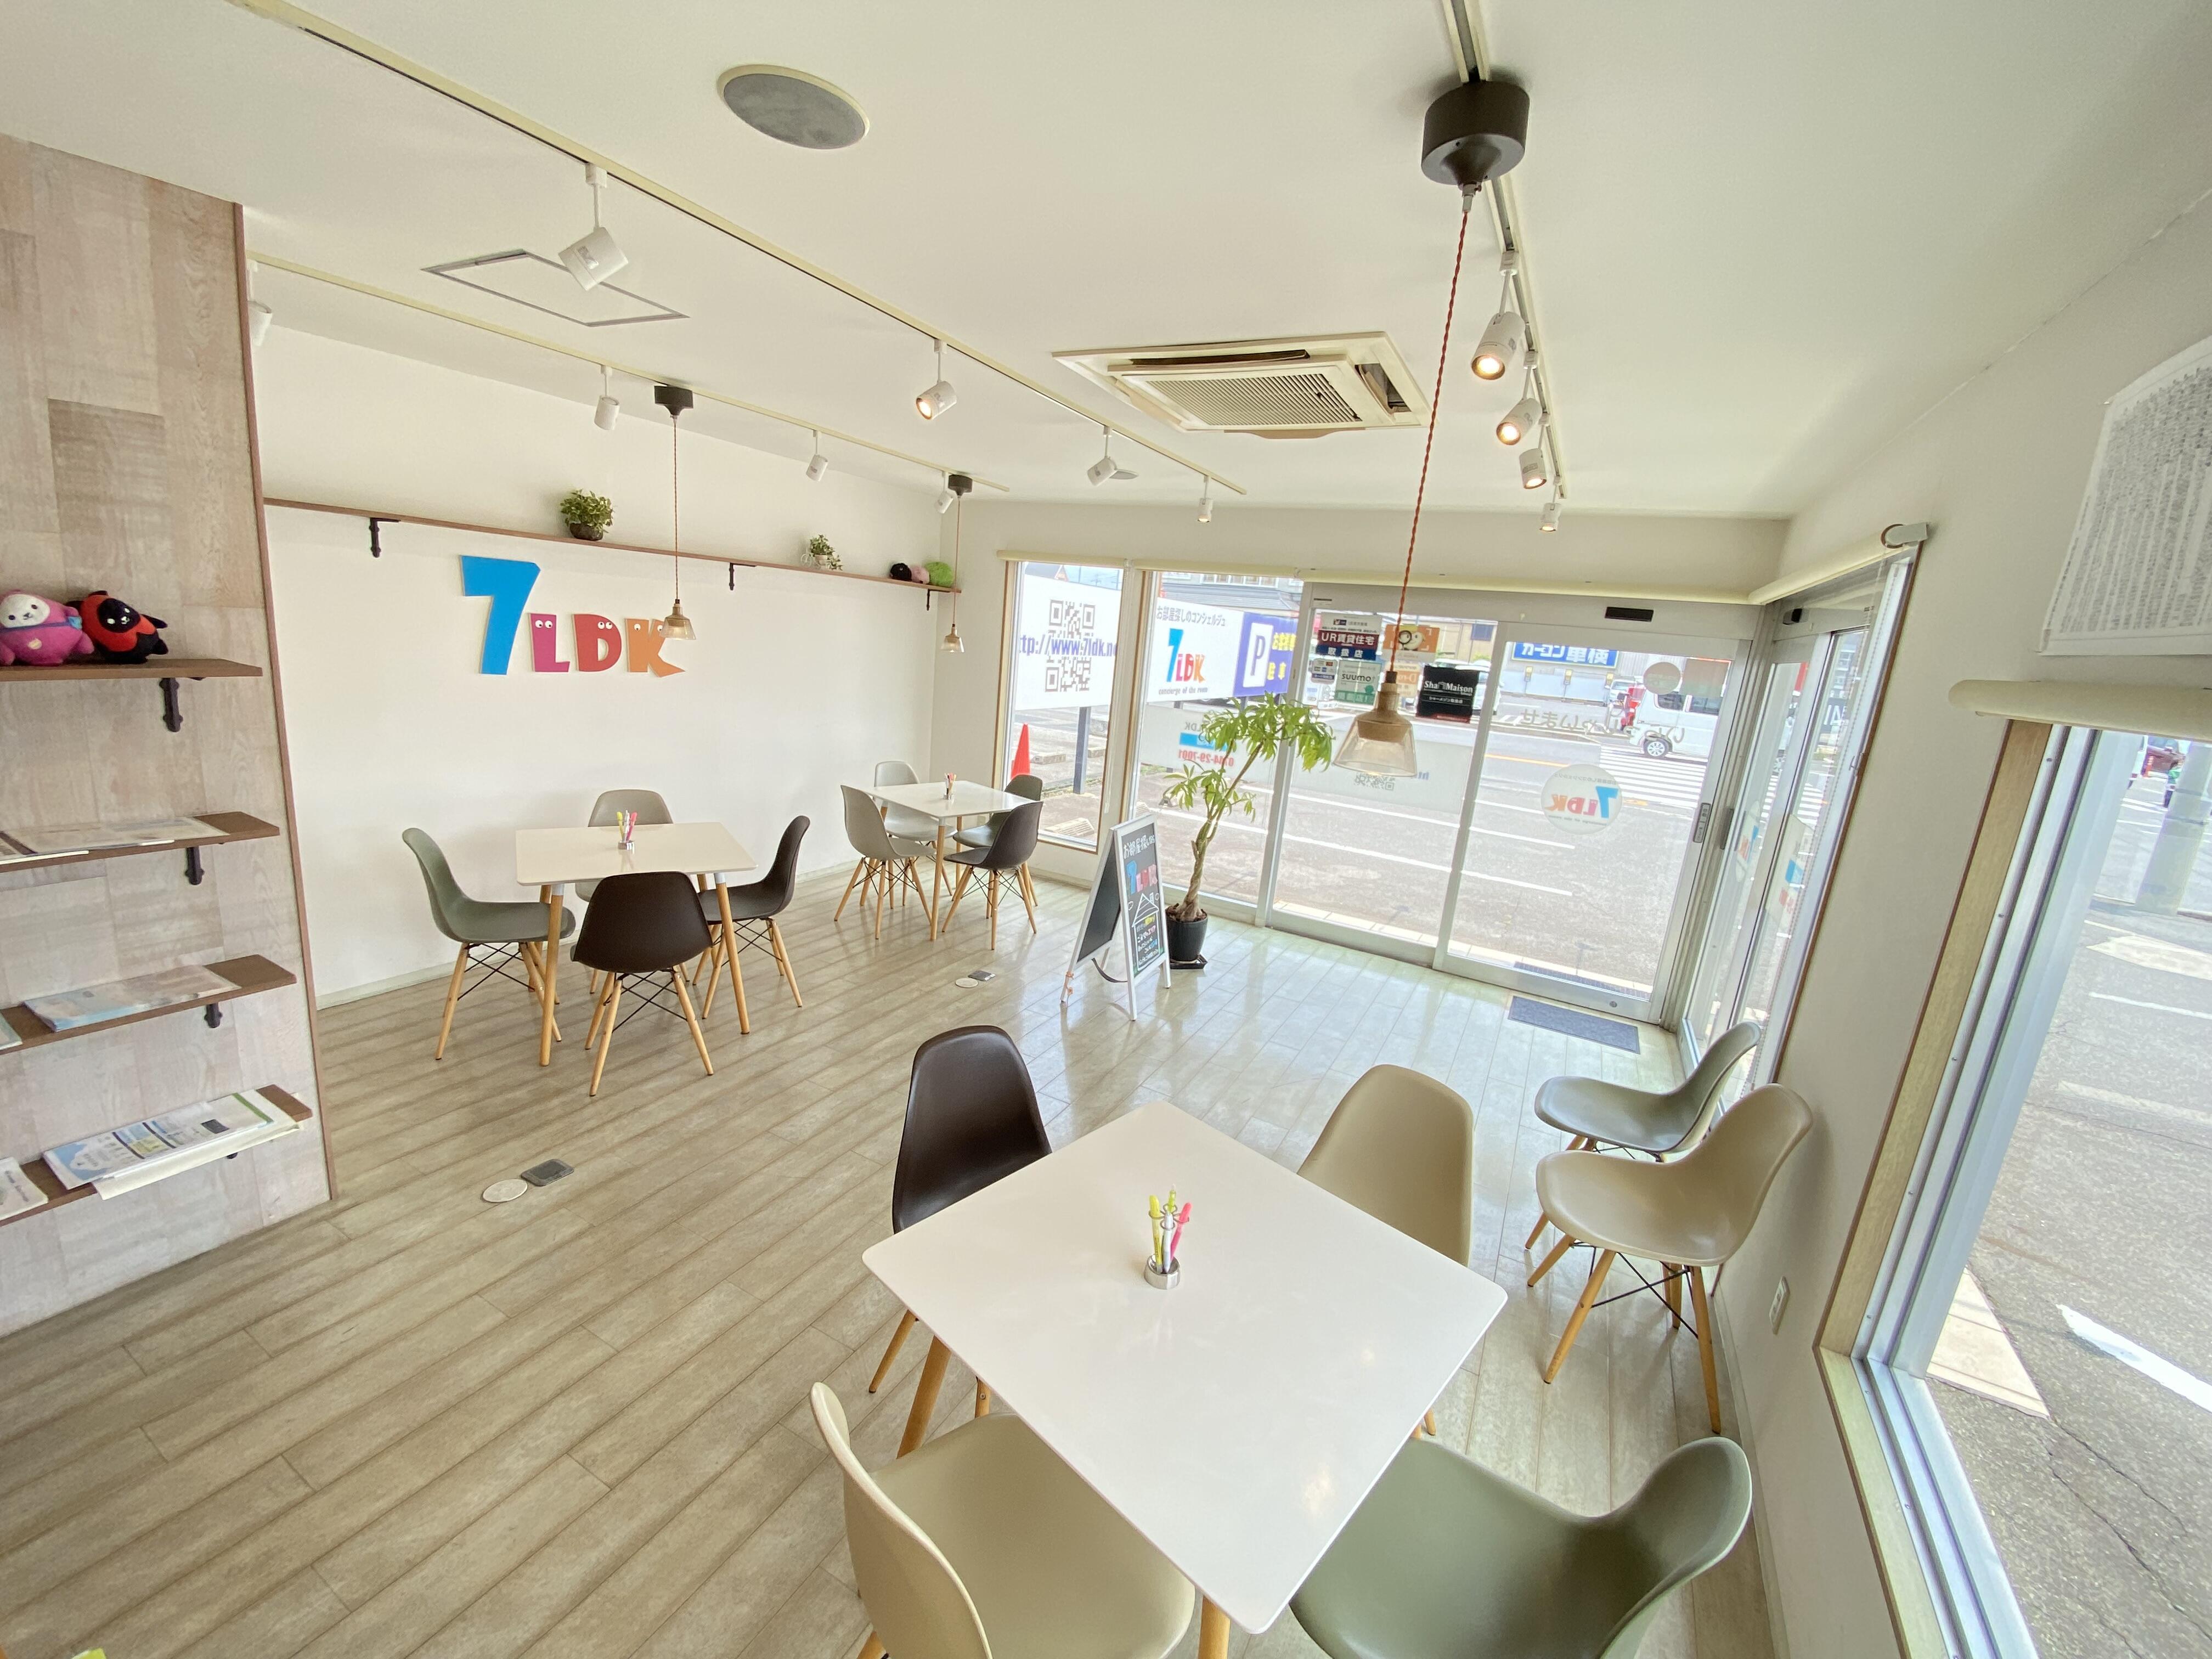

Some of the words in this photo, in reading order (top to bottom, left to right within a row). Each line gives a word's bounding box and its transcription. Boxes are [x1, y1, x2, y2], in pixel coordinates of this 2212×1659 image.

[460, 555, 686, 678] 7LDK
[1156, 605, 1226, 627] お部屋探しのコンシェルジュ
[1321, 632, 1375, 646] UR賃貸住宅
[1166, 628, 1205, 683] 7LDK
[1250, 635, 1266, 676] P
[1267, 662, 1286, 680] 駐車
[1341, 673, 1372, 682] suumo
[1446, 682, 1473, 693] Maison
